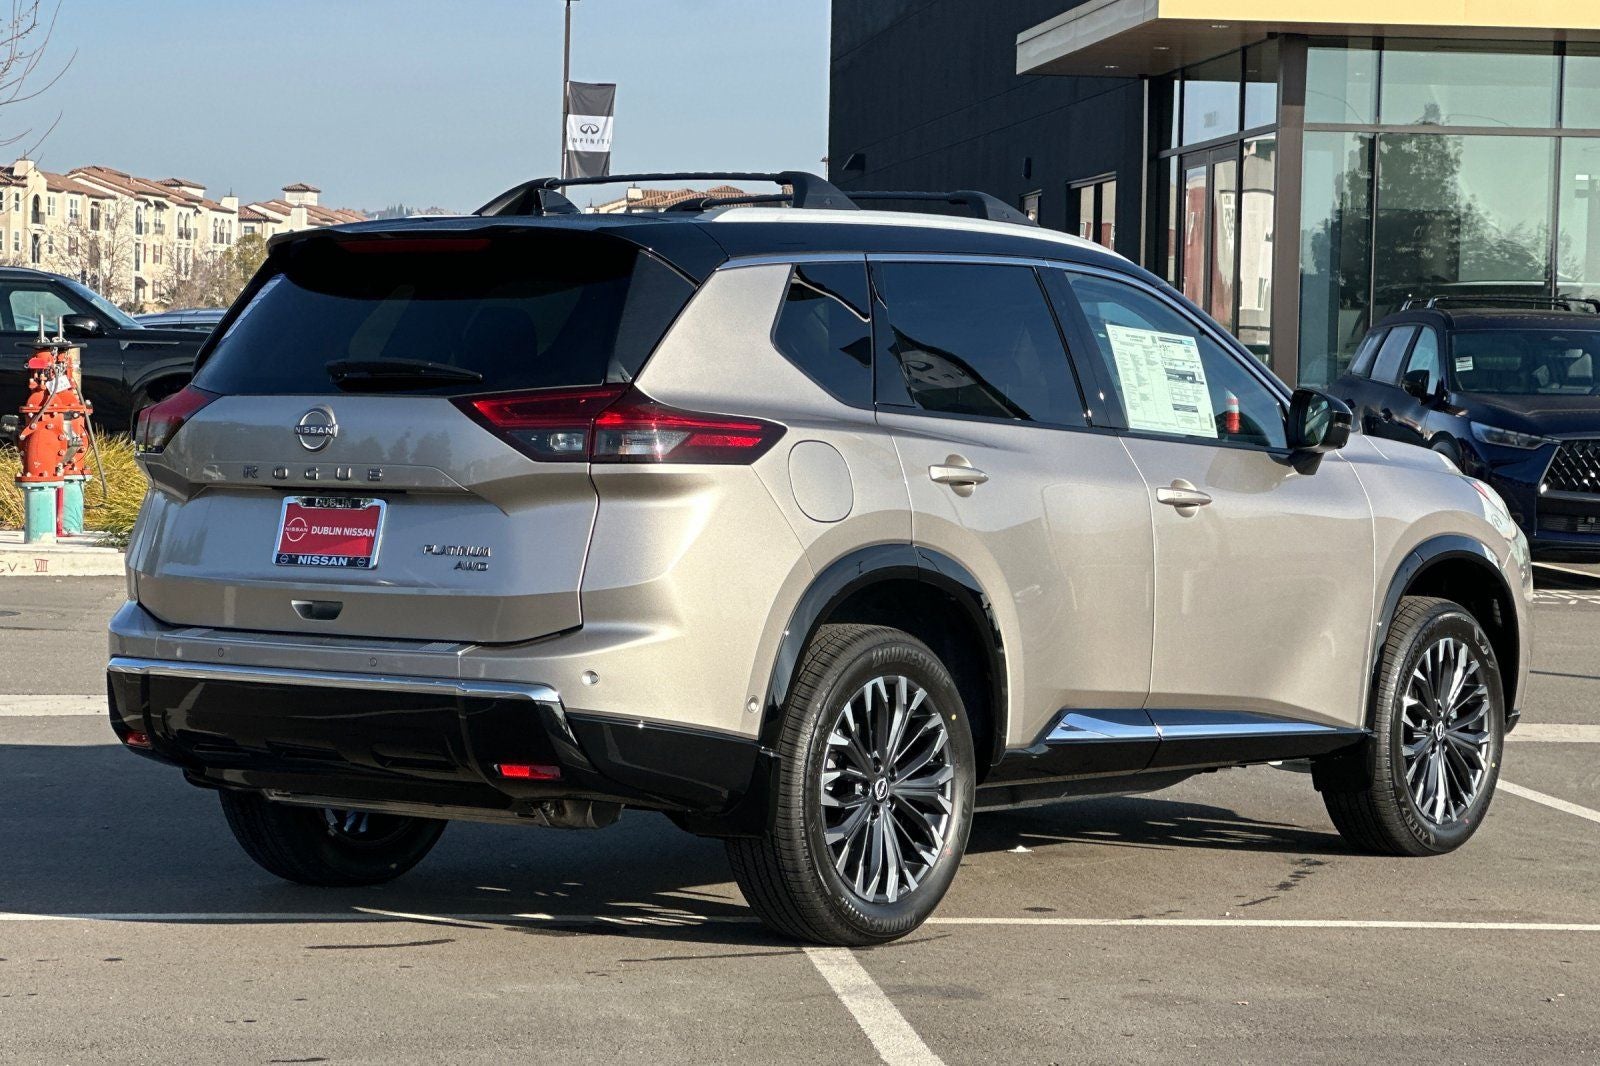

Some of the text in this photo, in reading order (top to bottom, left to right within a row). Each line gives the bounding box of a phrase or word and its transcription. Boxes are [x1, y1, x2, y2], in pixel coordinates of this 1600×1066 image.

[295, 424, 334, 435] NISSAN
[243, 465, 383, 481] ROGUE
[314, 498, 352, 508] DUBLIN
[311, 526, 376, 538] DUBLIN NISSAN
[422, 544, 492, 557] PLATINUM
[297, 555, 348, 566] NISSAN
[453, 560, 489, 571] AWD
[872, 647, 951, 688] BRIDGESTONE
